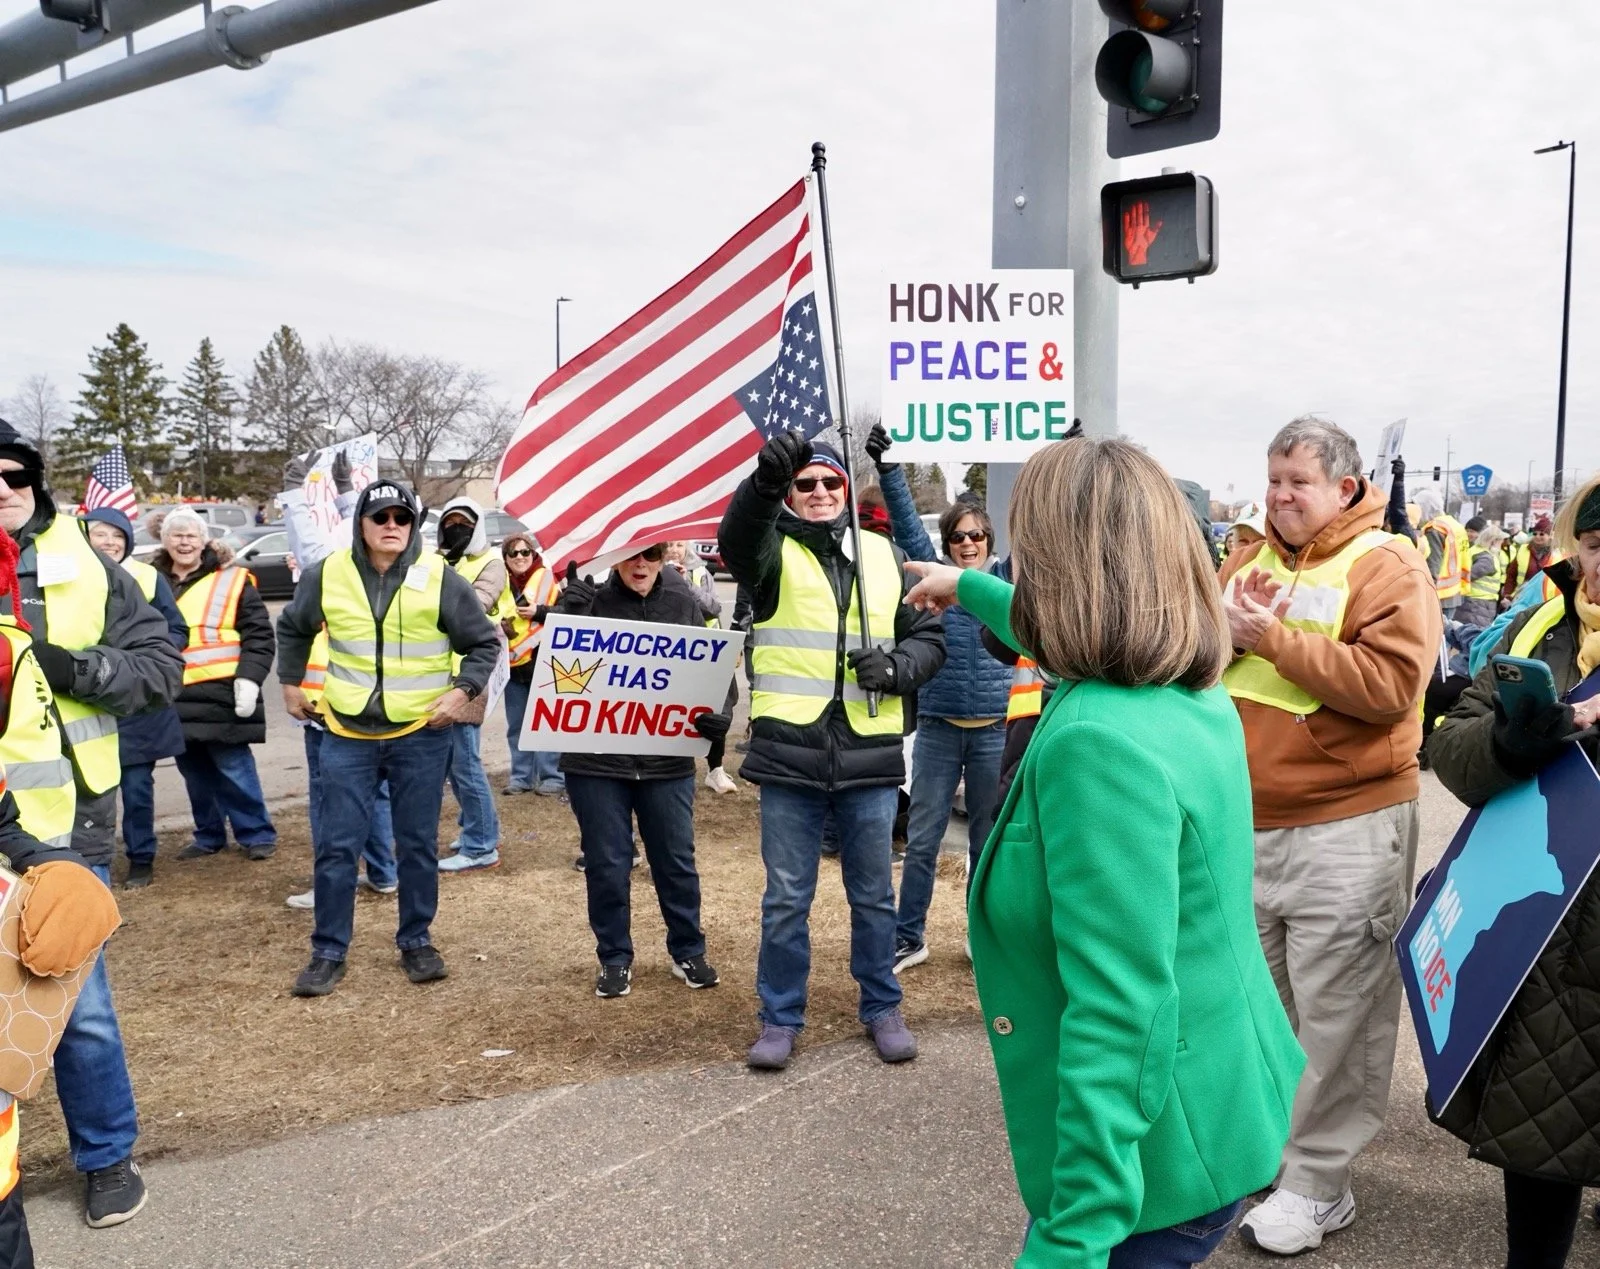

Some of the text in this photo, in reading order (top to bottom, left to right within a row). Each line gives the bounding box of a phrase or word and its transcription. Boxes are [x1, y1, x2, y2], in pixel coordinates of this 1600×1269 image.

[890, 283, 1065, 322] HONK FOR
[891, 341, 1064, 381] PEACE &
[890, 401, 1066, 442] JUSTICE
[369, 485, 407, 502] NAV
[1467, 474, 1486, 488] 28
[552, 627, 727, 662] DEMOCRACY
[608, 664, 672, 690] HAS
[531, 697, 714, 739] NO KINGS
[1435, 878, 1464, 942] MN
